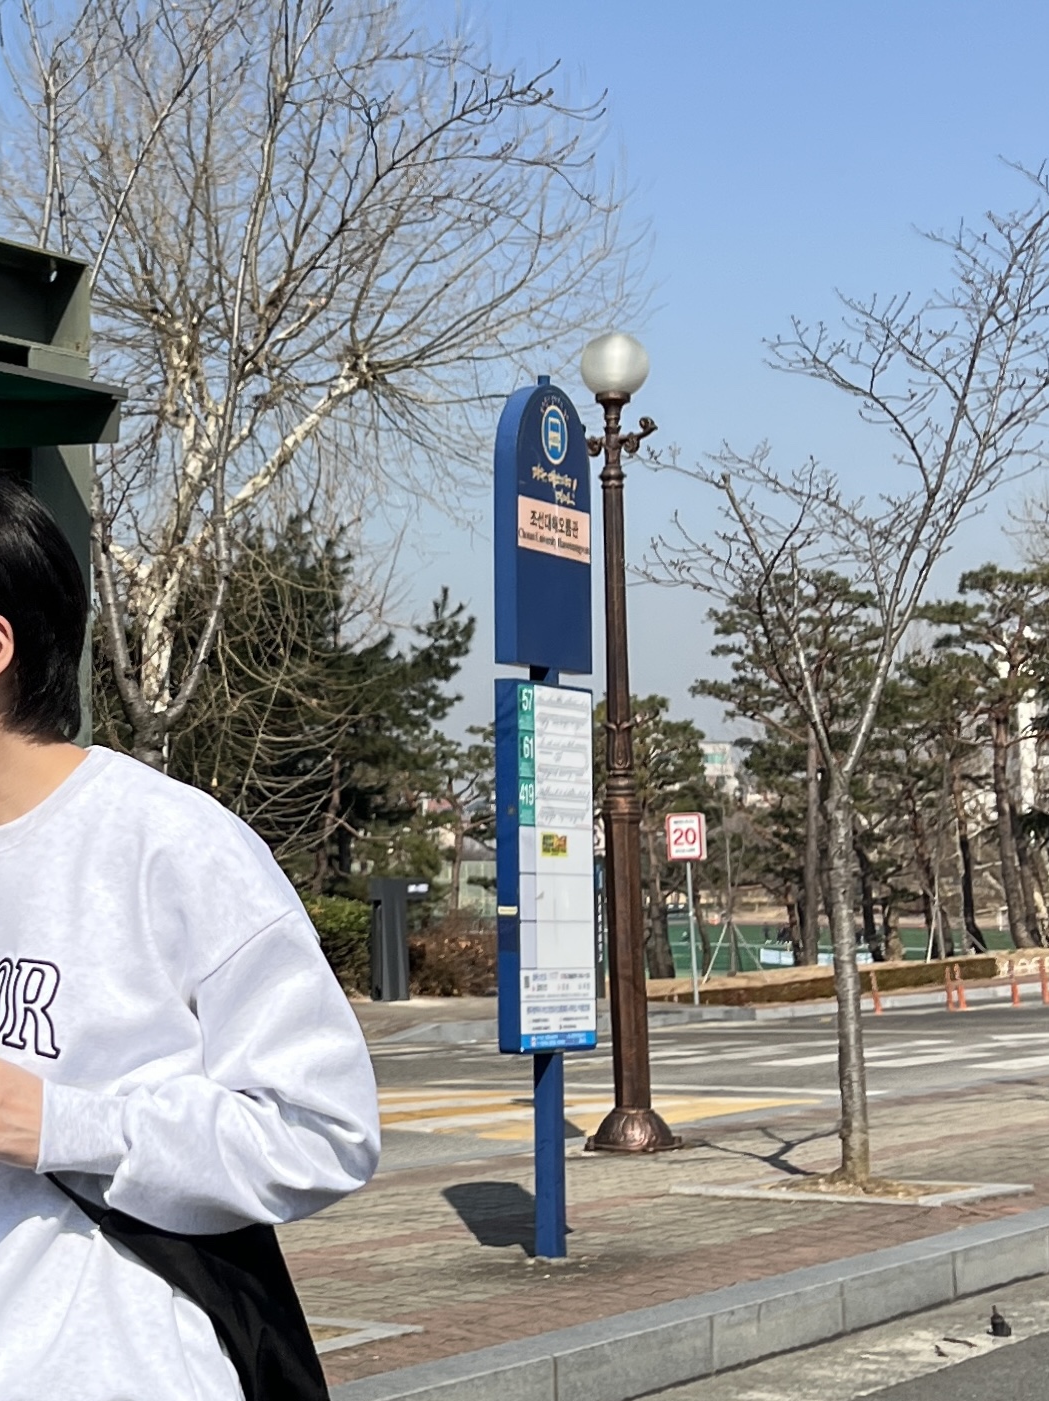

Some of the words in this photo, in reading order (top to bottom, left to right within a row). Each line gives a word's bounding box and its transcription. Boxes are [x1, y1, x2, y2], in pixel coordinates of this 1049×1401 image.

[521, 688, 533, 711] 57
[523, 735, 534, 759] 61
[519, 783, 535, 806] 419
[673, 827, 697, 846] 20
